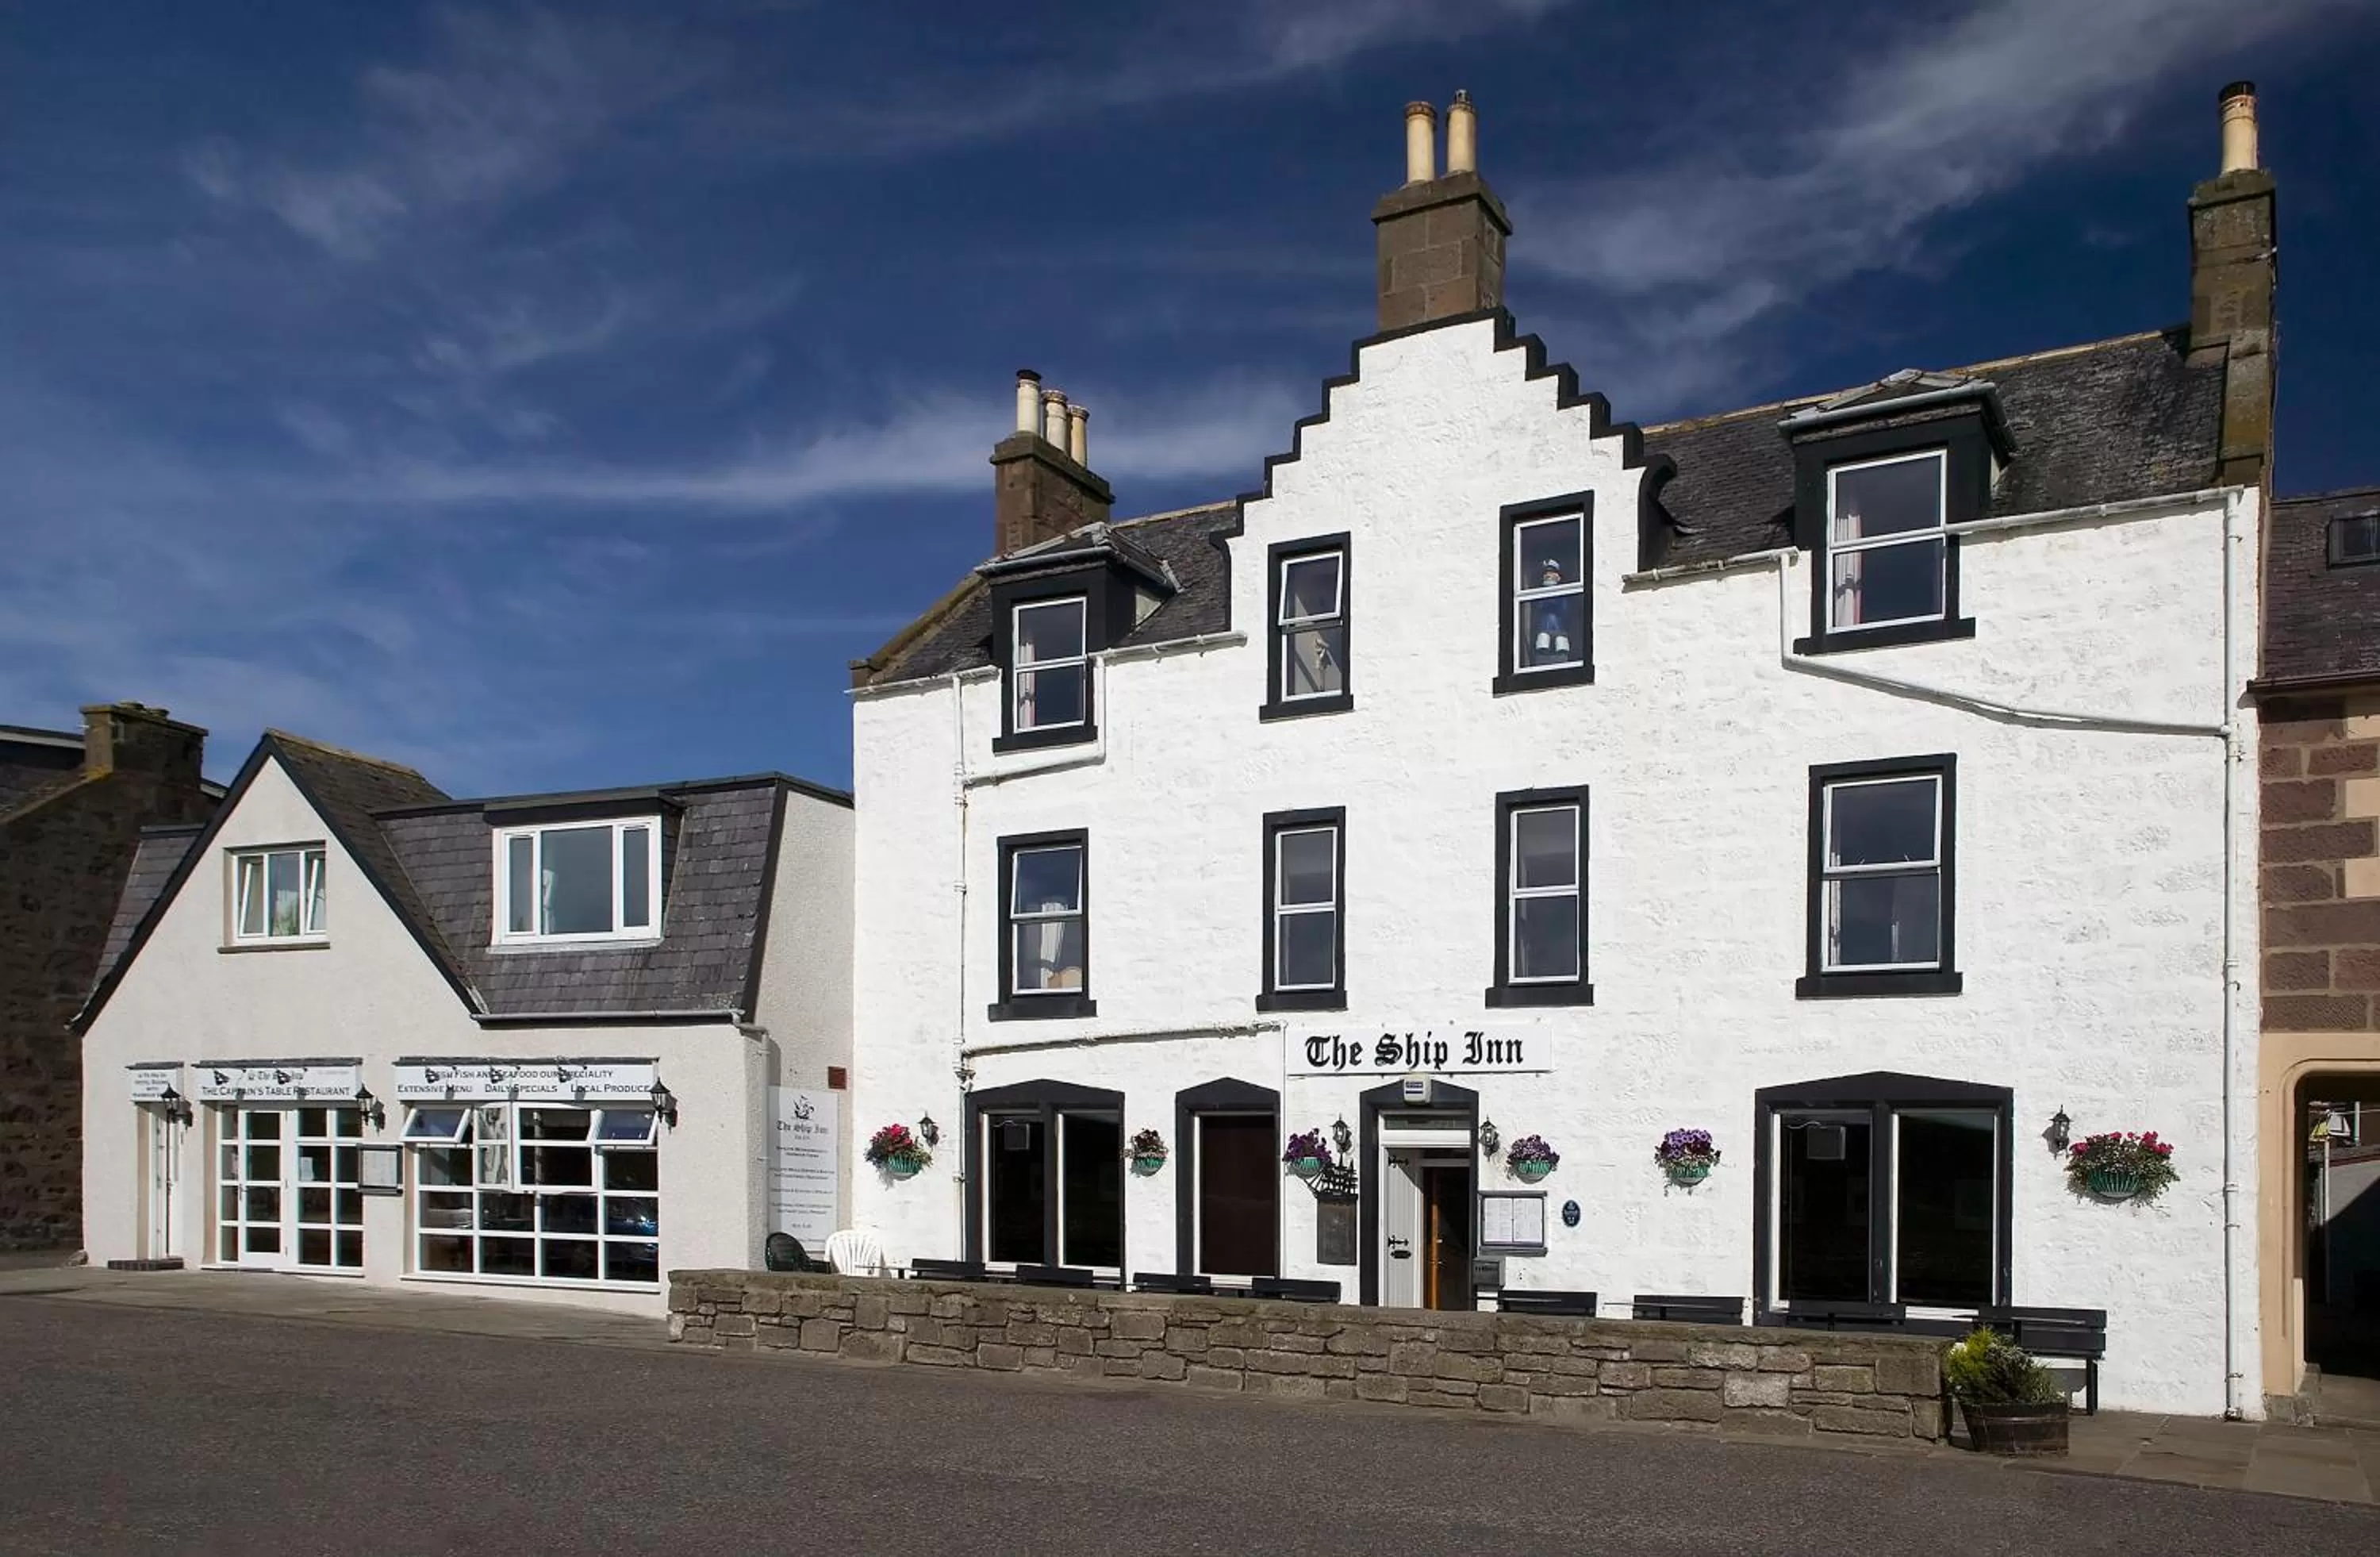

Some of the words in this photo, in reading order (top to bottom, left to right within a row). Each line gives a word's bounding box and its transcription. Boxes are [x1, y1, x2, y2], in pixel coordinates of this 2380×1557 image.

[1305, 1035, 1363, 1071] The
[1374, 1031, 1448, 1071] Ship
[1462, 1032, 1523, 1063] Inn
[485, 1084, 510, 1093] DAILY
[512, 1083, 558, 1093] SPECIALS
[571, 1084, 601, 1093] LOCAL
[605, 1084, 650, 1093] PRODUCE
